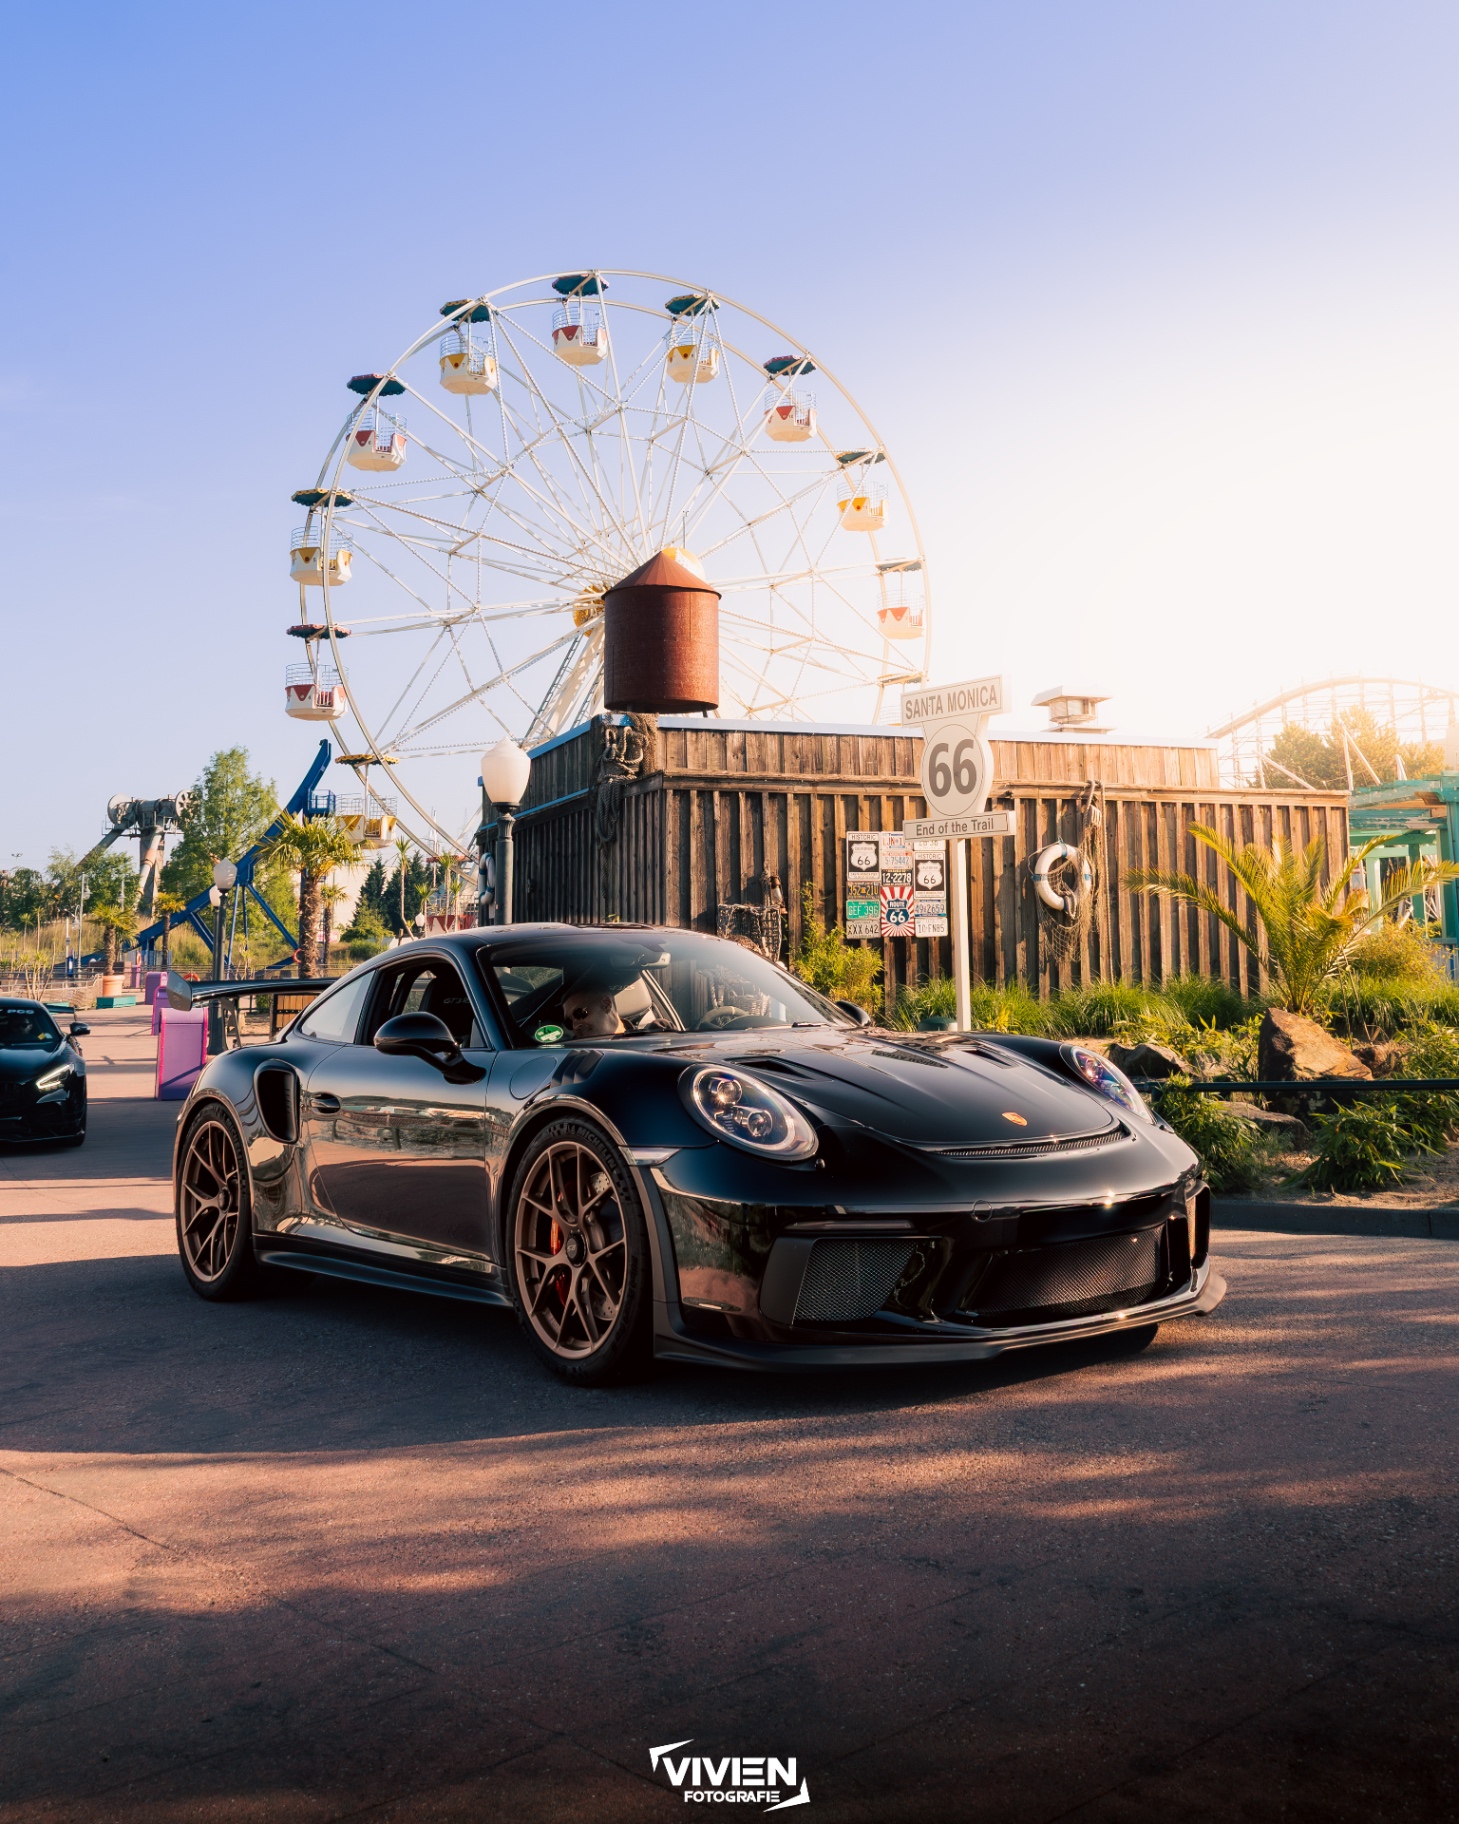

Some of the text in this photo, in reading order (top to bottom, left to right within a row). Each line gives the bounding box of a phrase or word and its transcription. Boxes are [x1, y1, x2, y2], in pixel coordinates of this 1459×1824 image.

[905, 684, 998, 720] SANTA MONICA
[928, 738, 977, 798] 66
[916, 824, 935, 836] End
[938, 822, 949, 834] of
[951, 821, 968, 833] the
[971, 817, 994, 831] Trail
[857, 855, 871, 866] 66
[923, 874, 937, 885] 66
[864, 905, 879, 916] 396
[889, 911, 906, 923] 66
[865, 924, 880, 935] 642
[577, 1126, 618, 1171] MICHELIN
